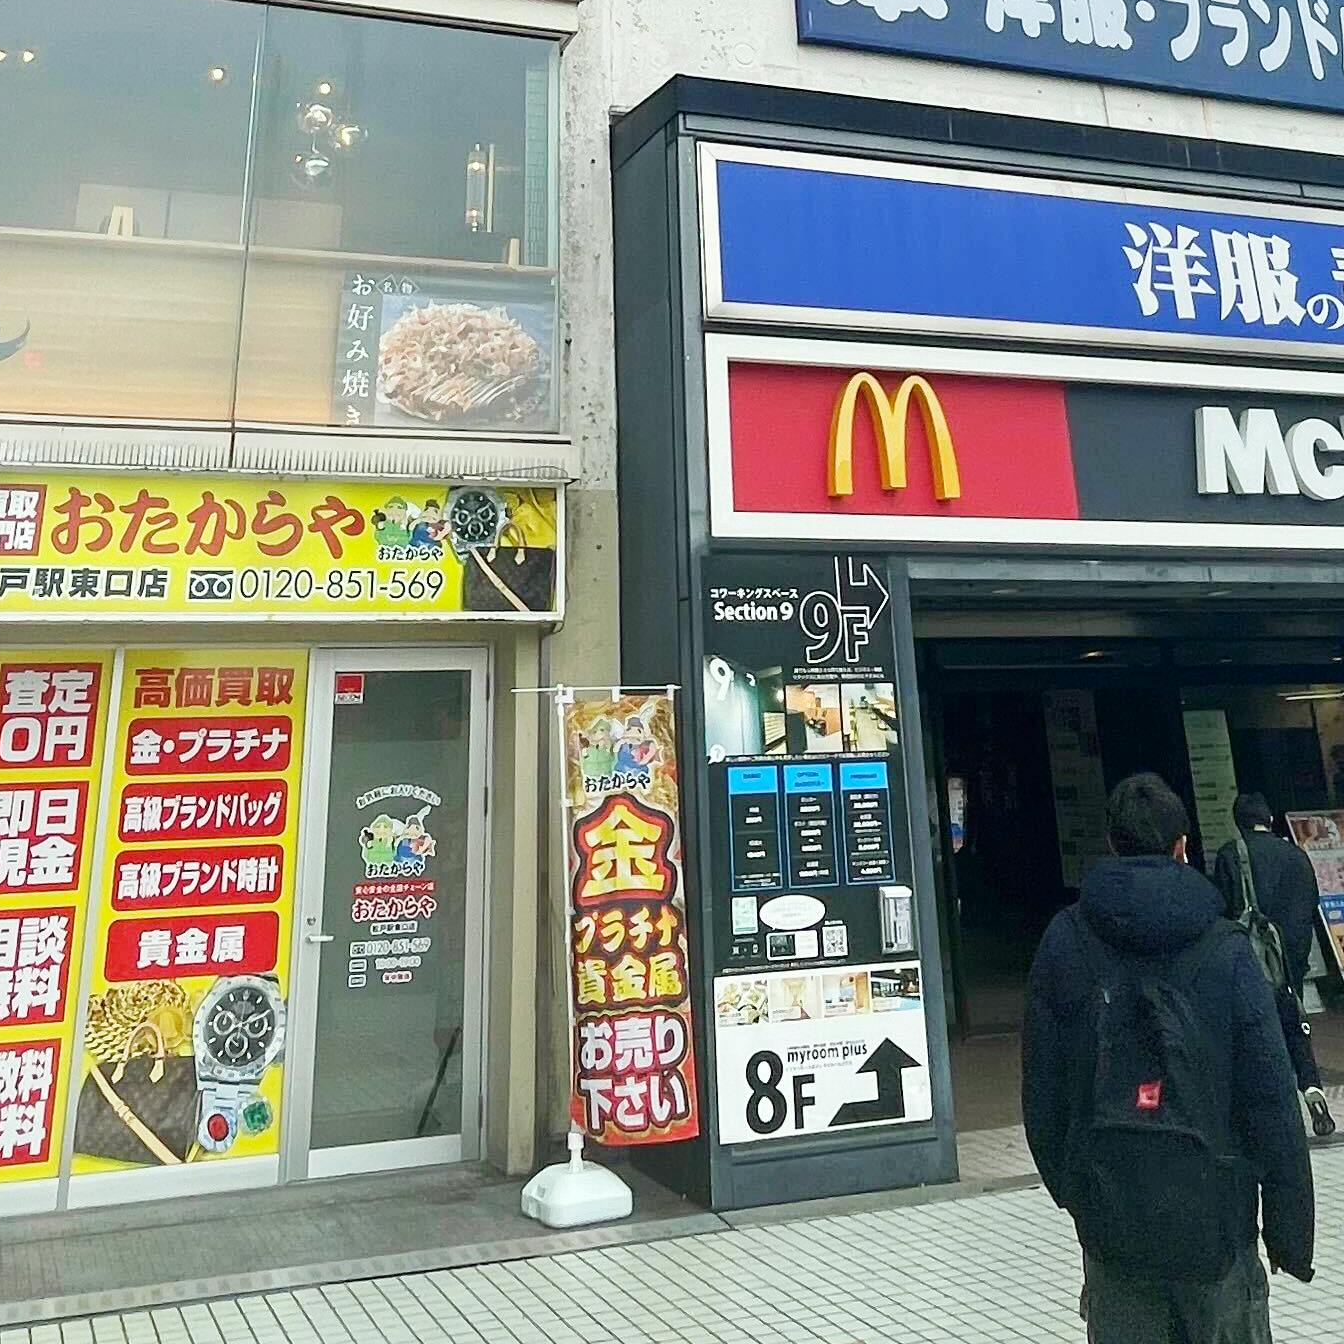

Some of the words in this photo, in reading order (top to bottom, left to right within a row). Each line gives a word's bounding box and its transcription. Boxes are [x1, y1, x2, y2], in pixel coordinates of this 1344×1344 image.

[50, 487, 366, 560] おたからや
[377, 546, 445, 564] おたからや
[238, 568, 445, 603] 0120-851-569
[713, 601, 777, 622] Section
[779, 601, 794, 621] 9
[799, 590, 870, 664] 9F
[4, 669, 93, 715] 査定
[133, 666, 296, 709] 高価買取
[129, 724, 290, 768] 金・プラチナ
[584, 773, 651, 793] おたからや
[121, 789, 283, 834] 高級ブランドバッグ
[367, 861, 424, 877] おたからや
[580, 803, 665, 899] 金
[117, 856, 280, 901] 高級ブランド時計
[353, 896, 436, 921] おたからや
[135, 924, 247, 969] 貴金属
[574, 908, 679, 956] プラチナ
[576, 954, 683, 1004] 貴金属
[579, 1014, 686, 1071] お売り
[787, 1046, 841, 1064] myroom
[842, 1041, 868, 1059] plus
[580, 1071, 687, 1131] 下さい
[745, 1049, 816, 1135] 8F
